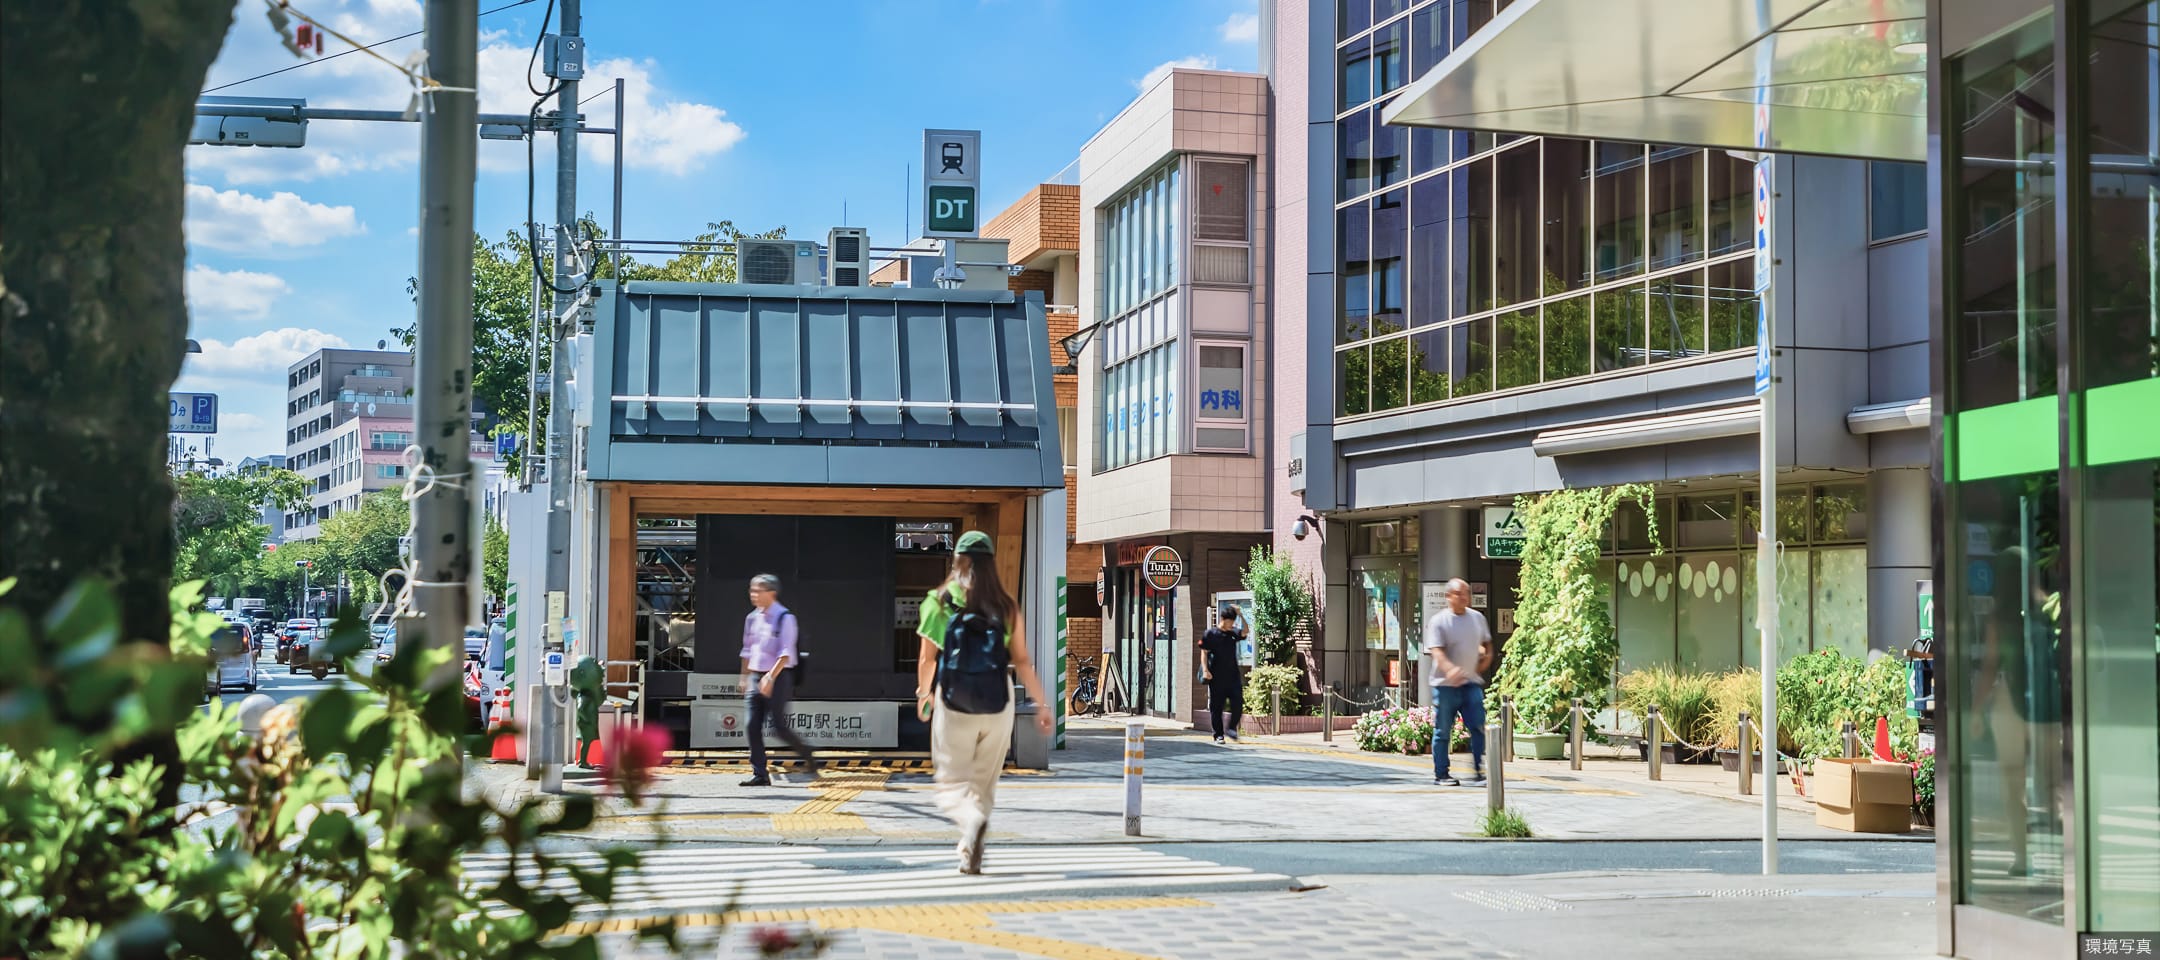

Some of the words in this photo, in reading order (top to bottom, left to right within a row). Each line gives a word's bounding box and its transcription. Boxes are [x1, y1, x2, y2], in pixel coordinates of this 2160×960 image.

[935, 198, 969, 219] DT
[198, 398, 209, 414] P
[1200, 388, 1240, 411] 内科
[1495, 548, 1521, 556] サービ
[834, 715, 862, 729] 北口
[836, 730, 857, 739] North
